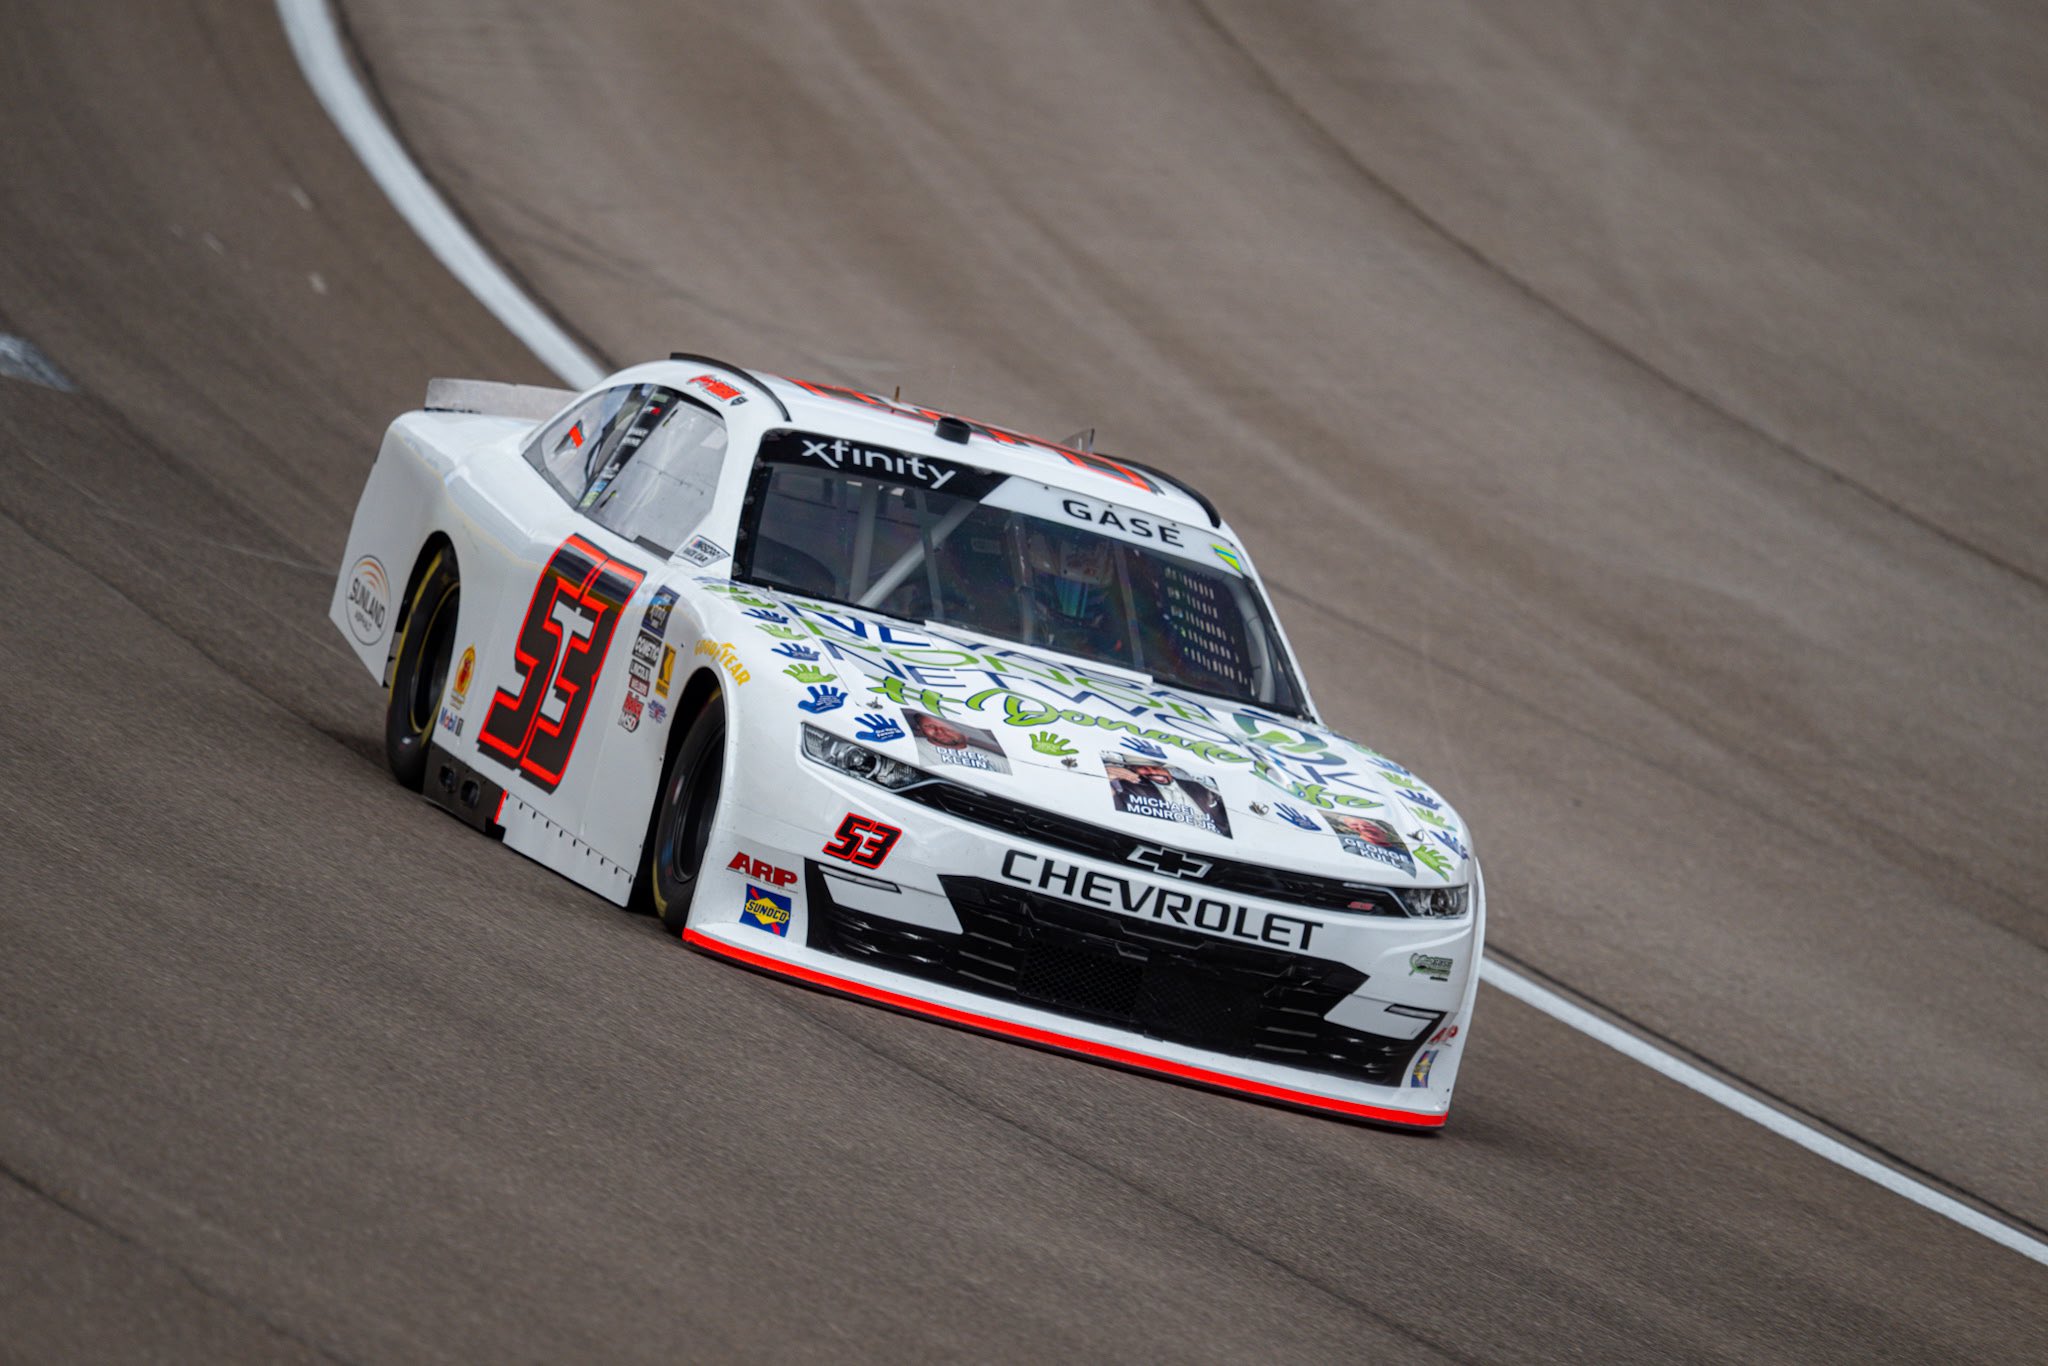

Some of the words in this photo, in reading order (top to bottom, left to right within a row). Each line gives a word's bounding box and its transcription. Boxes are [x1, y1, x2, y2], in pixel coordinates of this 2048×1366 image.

[802, 439, 956, 490] xfinity
[1062, 498, 1184, 548] GASE
[348, 577, 386, 629] SUNLAND
[476, 533, 647, 795] 53
[694, 639, 752, 687] GOODYEAR
[438, 706, 458, 733] Mobil
[935, 747, 989, 761] DEREK
[940, 753, 989, 770] KLEIN
[1126, 803, 1196, 826] MONROE
[1128, 794, 1197, 816] MICHAEL
[822, 812, 902, 870] 53
[1344, 838, 1410, 865] GEORGE
[727, 851, 798, 887] ARP
[1360, 849, 1402, 869] KULL
[746, 901, 788, 922] SUNOCO
[1001, 849, 1324, 951] CHEVROLET
